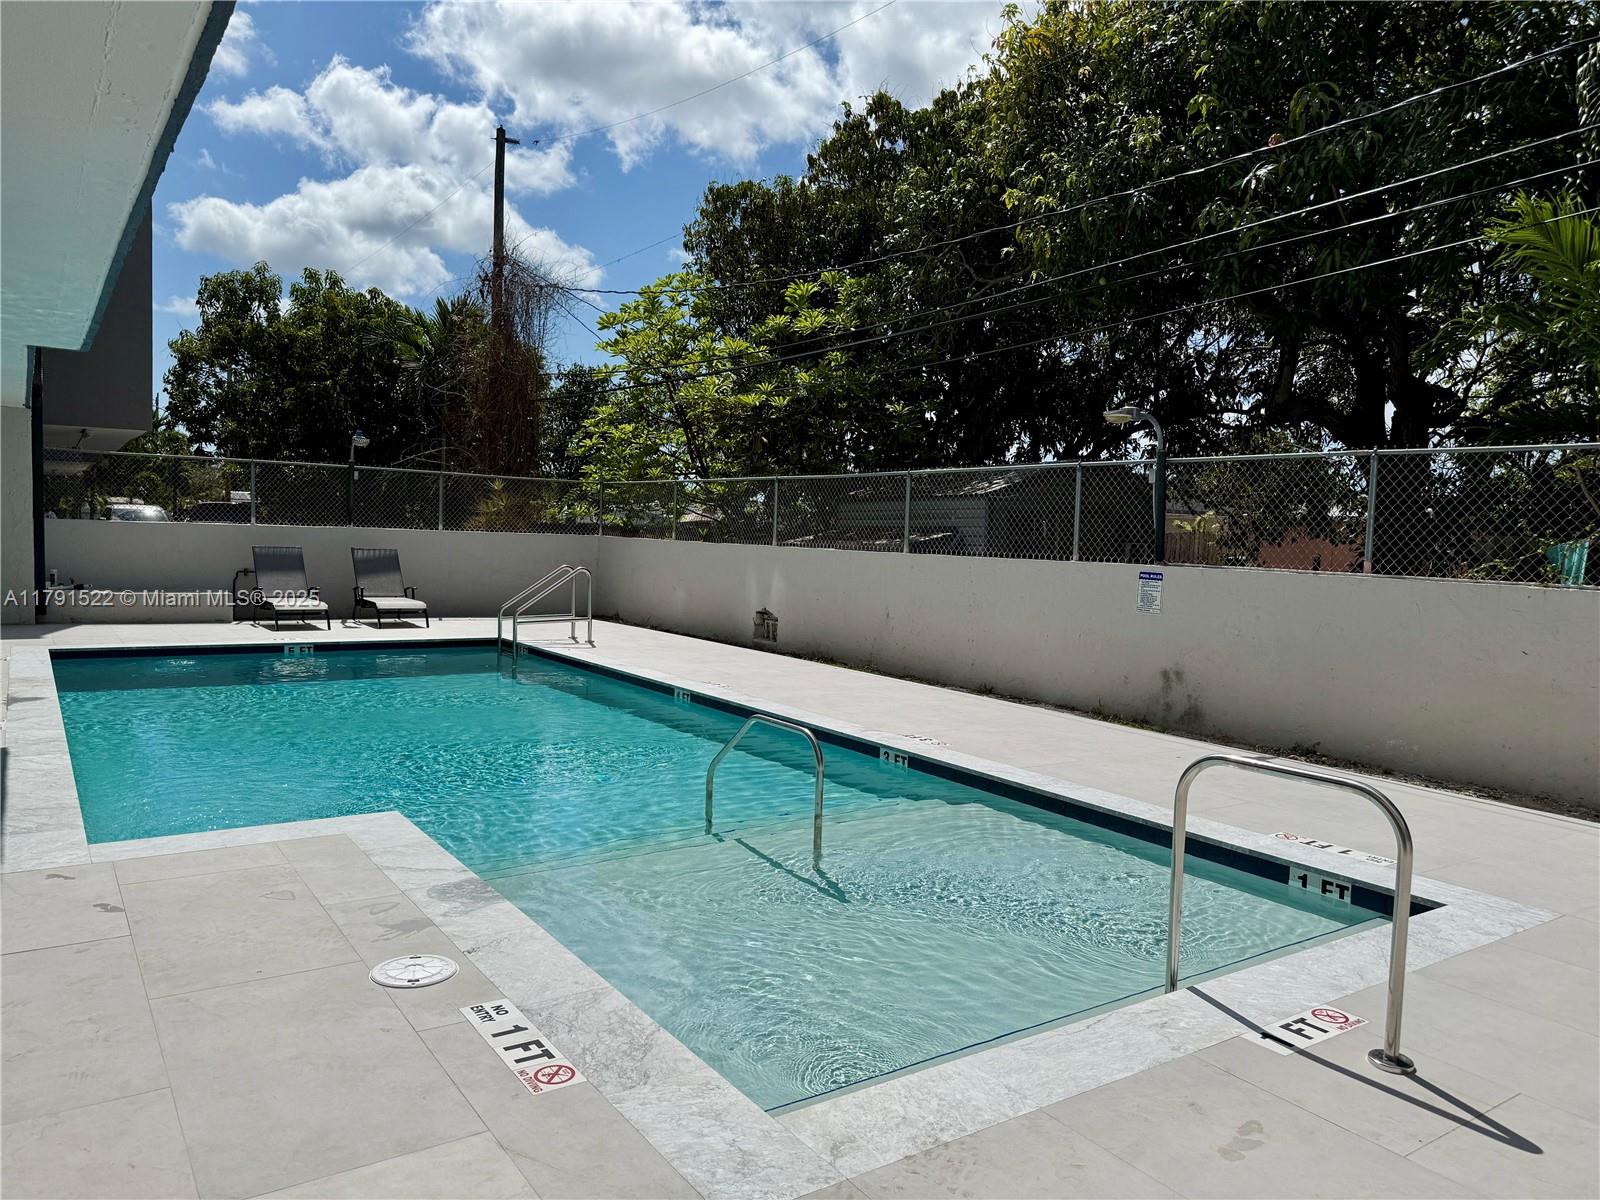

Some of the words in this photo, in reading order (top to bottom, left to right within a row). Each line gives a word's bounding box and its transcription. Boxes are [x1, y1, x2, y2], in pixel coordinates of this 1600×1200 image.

[883, 750, 890, 761] 3
[894, 753, 907, 766] FT
[1297, 873, 1308, 889] 1
[1321, 878, 1350, 900] FT
[470, 1005, 496, 1022] ENTRY
[491, 1004, 509, 1016] NO
[490, 1024, 529, 1038] 1
[1278, 1017, 1329, 1040] FT
[502, 1039, 556, 1064] FT
[516, 1069, 529, 1077] NO
[522, 1076, 543, 1093] DIVING
